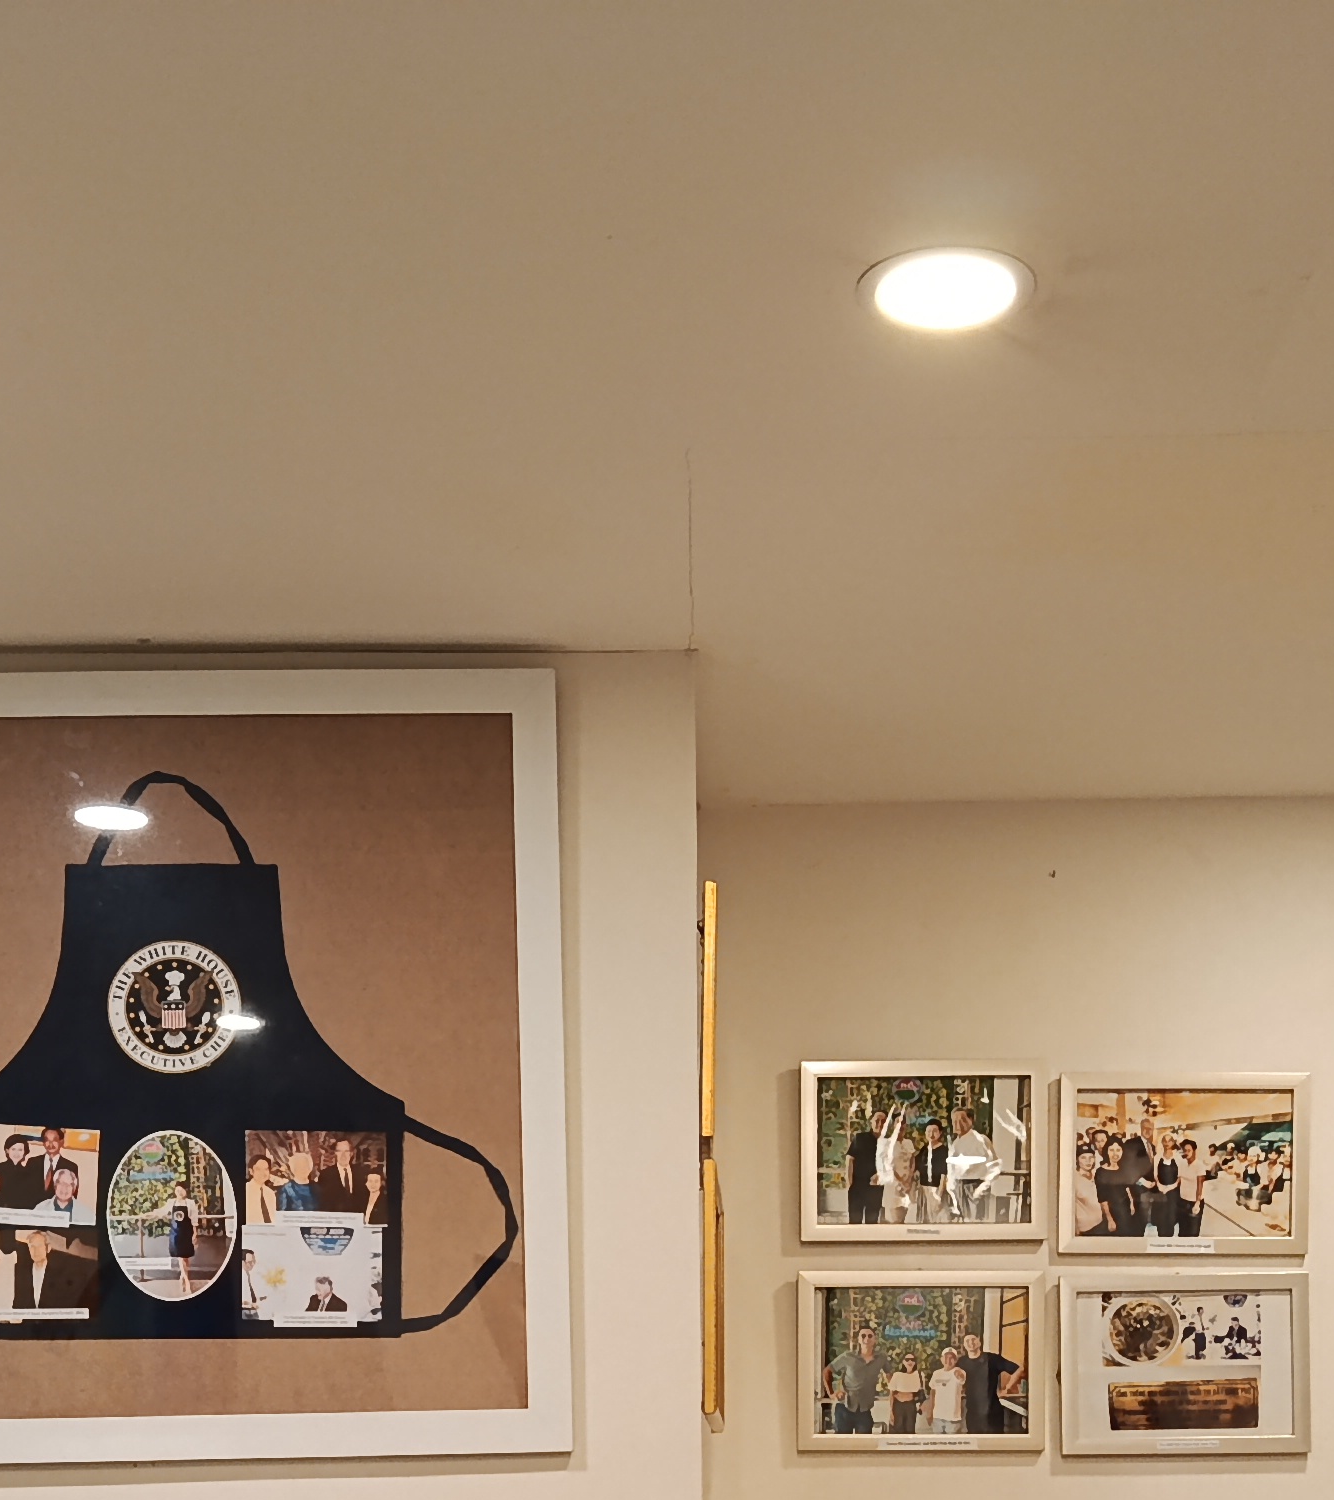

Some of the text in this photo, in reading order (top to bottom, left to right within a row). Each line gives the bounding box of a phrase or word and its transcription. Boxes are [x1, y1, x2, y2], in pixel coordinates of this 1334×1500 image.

[113, 944, 236, 1002] THE WHITE HOUSE
[117, 1026, 200, 1068] EXECUTIVE
